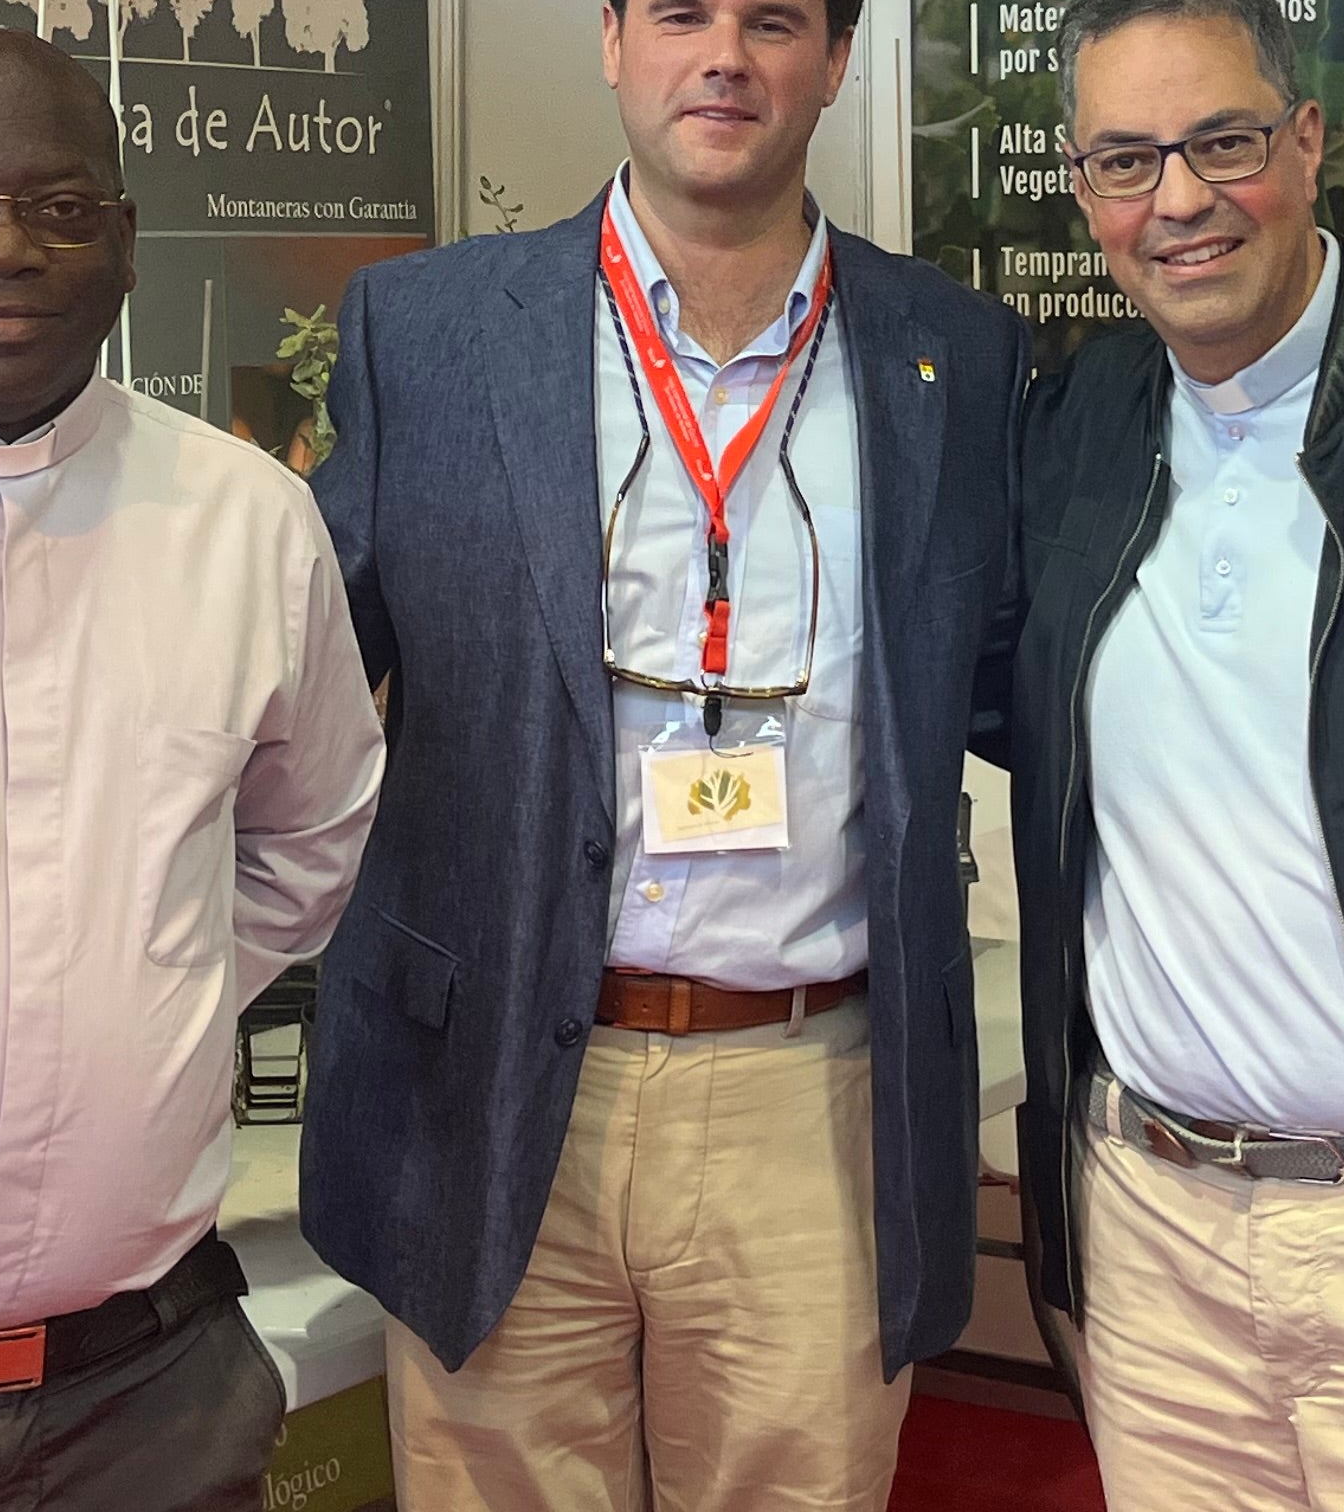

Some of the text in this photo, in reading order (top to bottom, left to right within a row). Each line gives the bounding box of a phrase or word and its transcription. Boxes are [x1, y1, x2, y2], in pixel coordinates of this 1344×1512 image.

[999, 48, 1041, 81] por
[175, 85, 229, 157] de
[245, 93, 383, 155] Autor
[999, 122, 1046, 155] Alta
[207, 192, 417, 220] Montaneras con Garantía
[1000, 246, 1108, 284] Tempran
